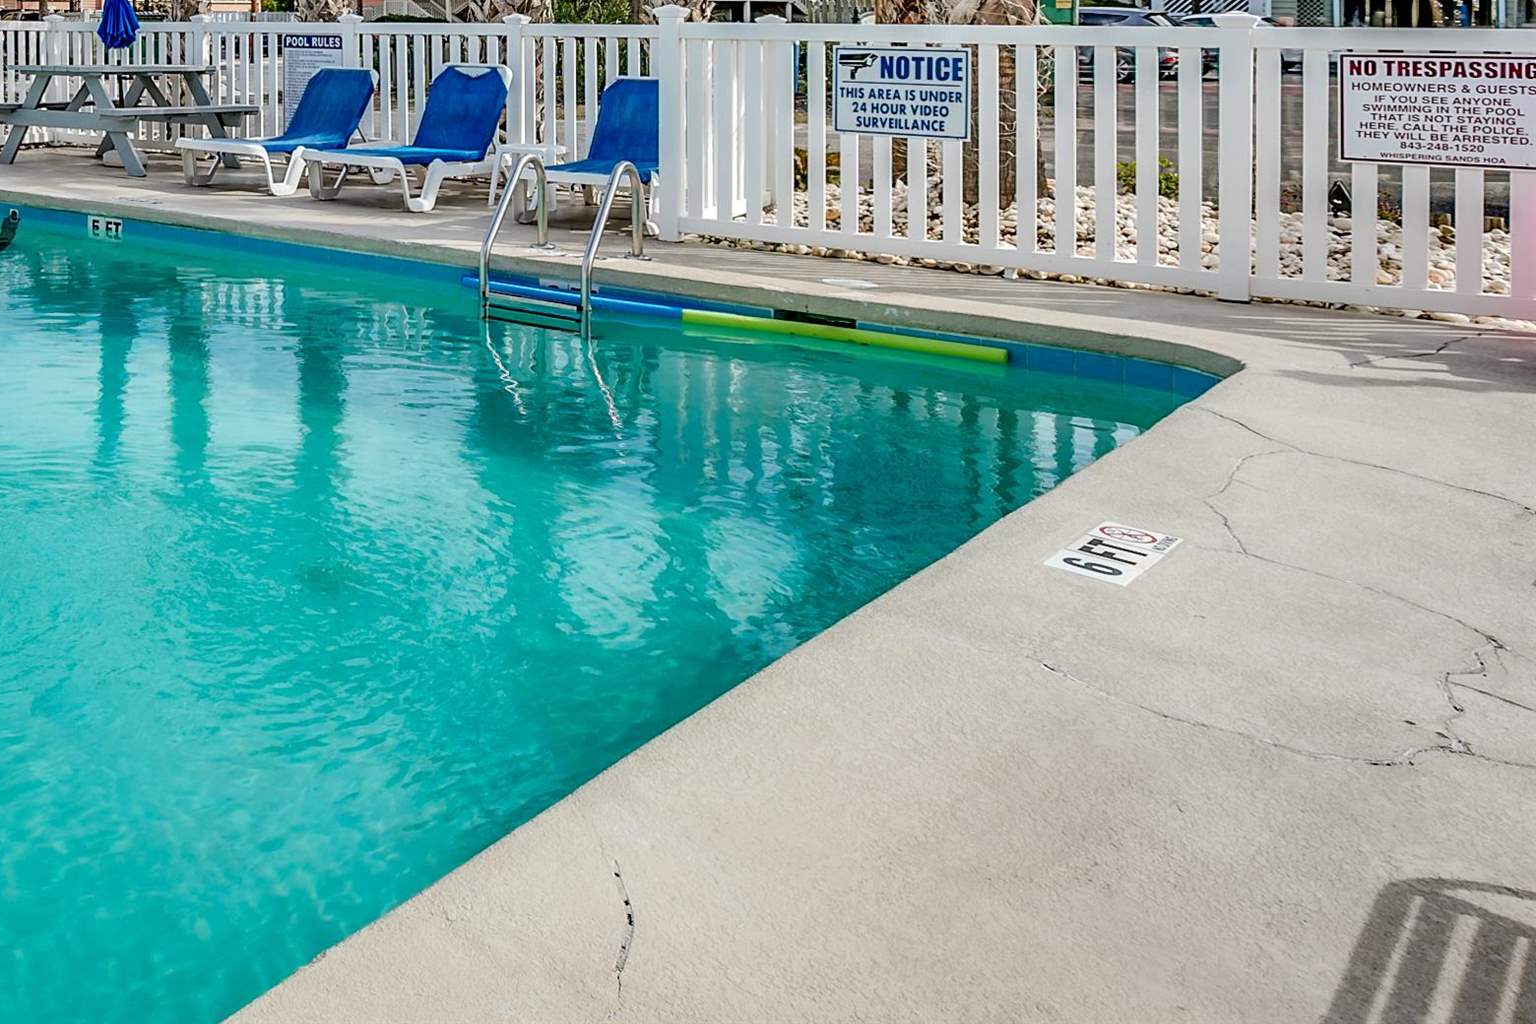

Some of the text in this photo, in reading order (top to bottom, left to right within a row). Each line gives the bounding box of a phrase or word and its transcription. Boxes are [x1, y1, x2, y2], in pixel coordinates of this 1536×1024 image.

[286, 37, 340, 47] POOL RULES
[880, 56, 963, 81] NOTICE
[1350, 60, 1536, 79] NO TRESPASSING
[840, 87, 962, 103] THIS AREA IS UNDER
[1351, 82, 1536, 95] HOMEOWNERS & GUESTS
[1374, 95, 1385, 103] IF
[1453, 97, 1512, 106] ANYONE
[852, 102, 949, 117] 24 HOUR VIDEO
[1363, 104, 1525, 116] SWIMMING IN THE POOL
[856, 117, 945, 131] SURVEILLANCE
[1371, 113, 1516, 125] THAT IS NOT STAYING
[1403, 124, 1439, 132] CALL
[1442, 125, 1468, 133] THE
[1355, 131, 1389, 139] THEY
[1394, 133, 1426, 141] WILL
[1452, 135, 1533, 145] ARRESTED.
[1400, 142, 1484, 153] 843-248-1520
[1380, 152, 1442, 161] WHISPERING
[1063, 538, 1147, 576] 6 FT
